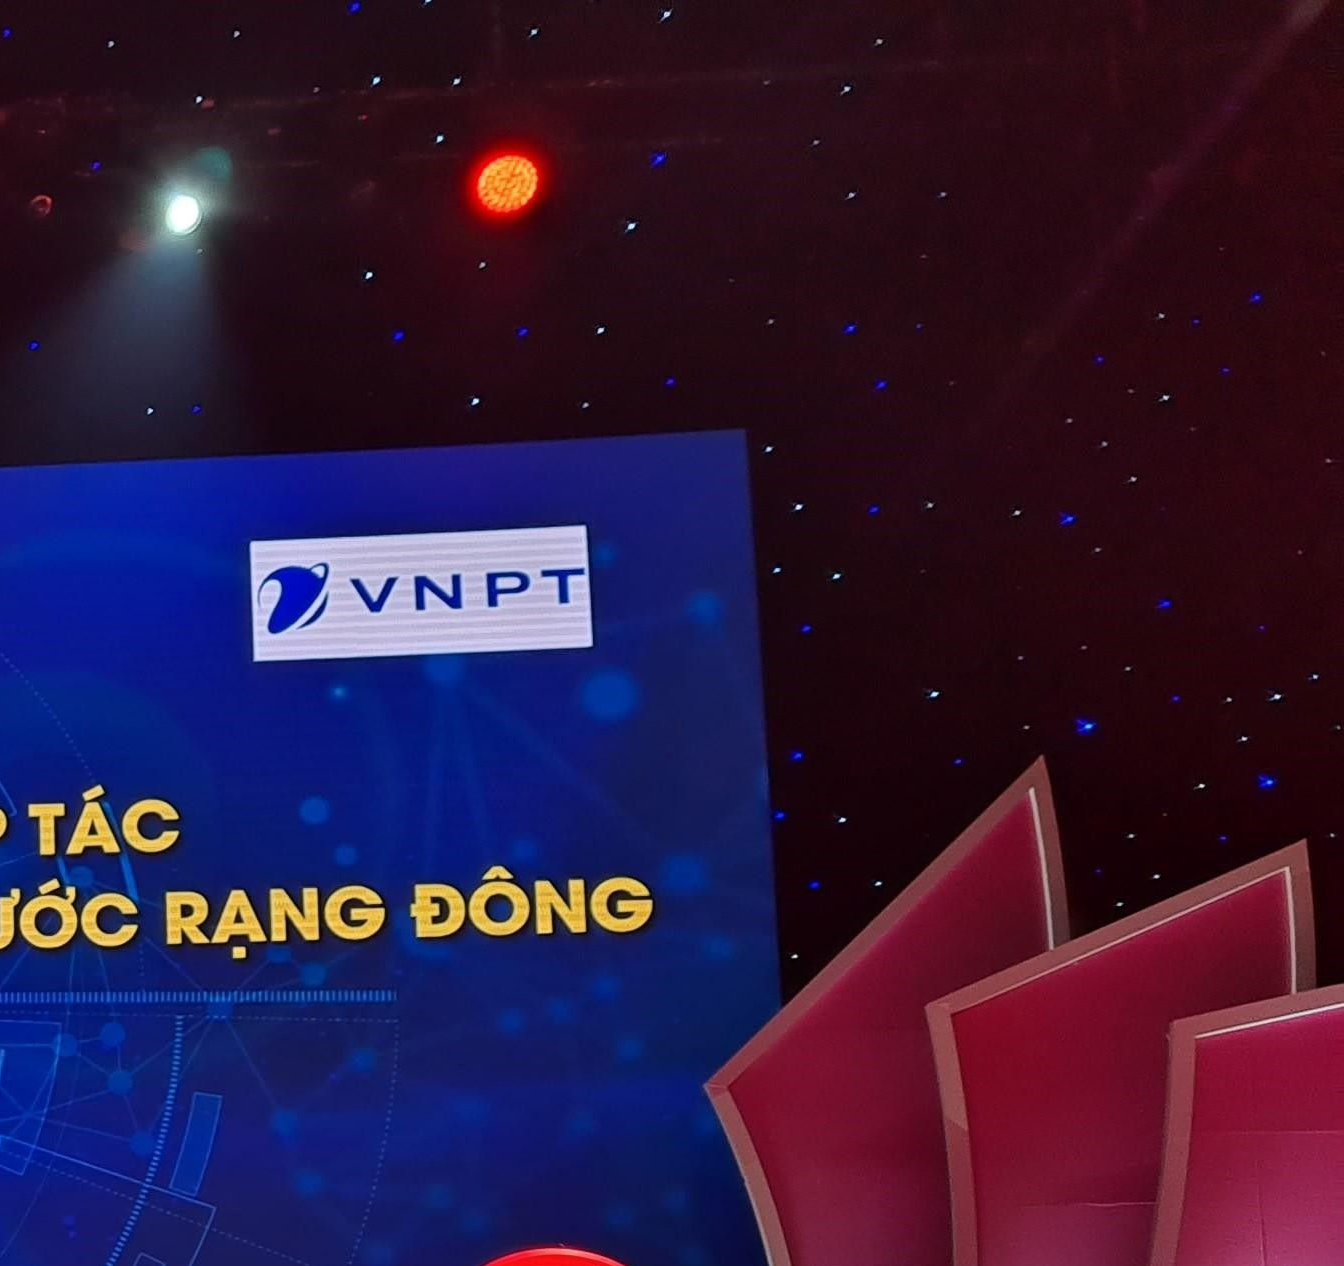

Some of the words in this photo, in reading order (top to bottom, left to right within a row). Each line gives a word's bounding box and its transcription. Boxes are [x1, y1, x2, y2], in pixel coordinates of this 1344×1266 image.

[350, 567, 585, 613] VNPT
[29, 788, 178, 854] TÁC
[167, 887, 385, 958] RẠNG
[412, 868, 652, 937] ĐÔNG
